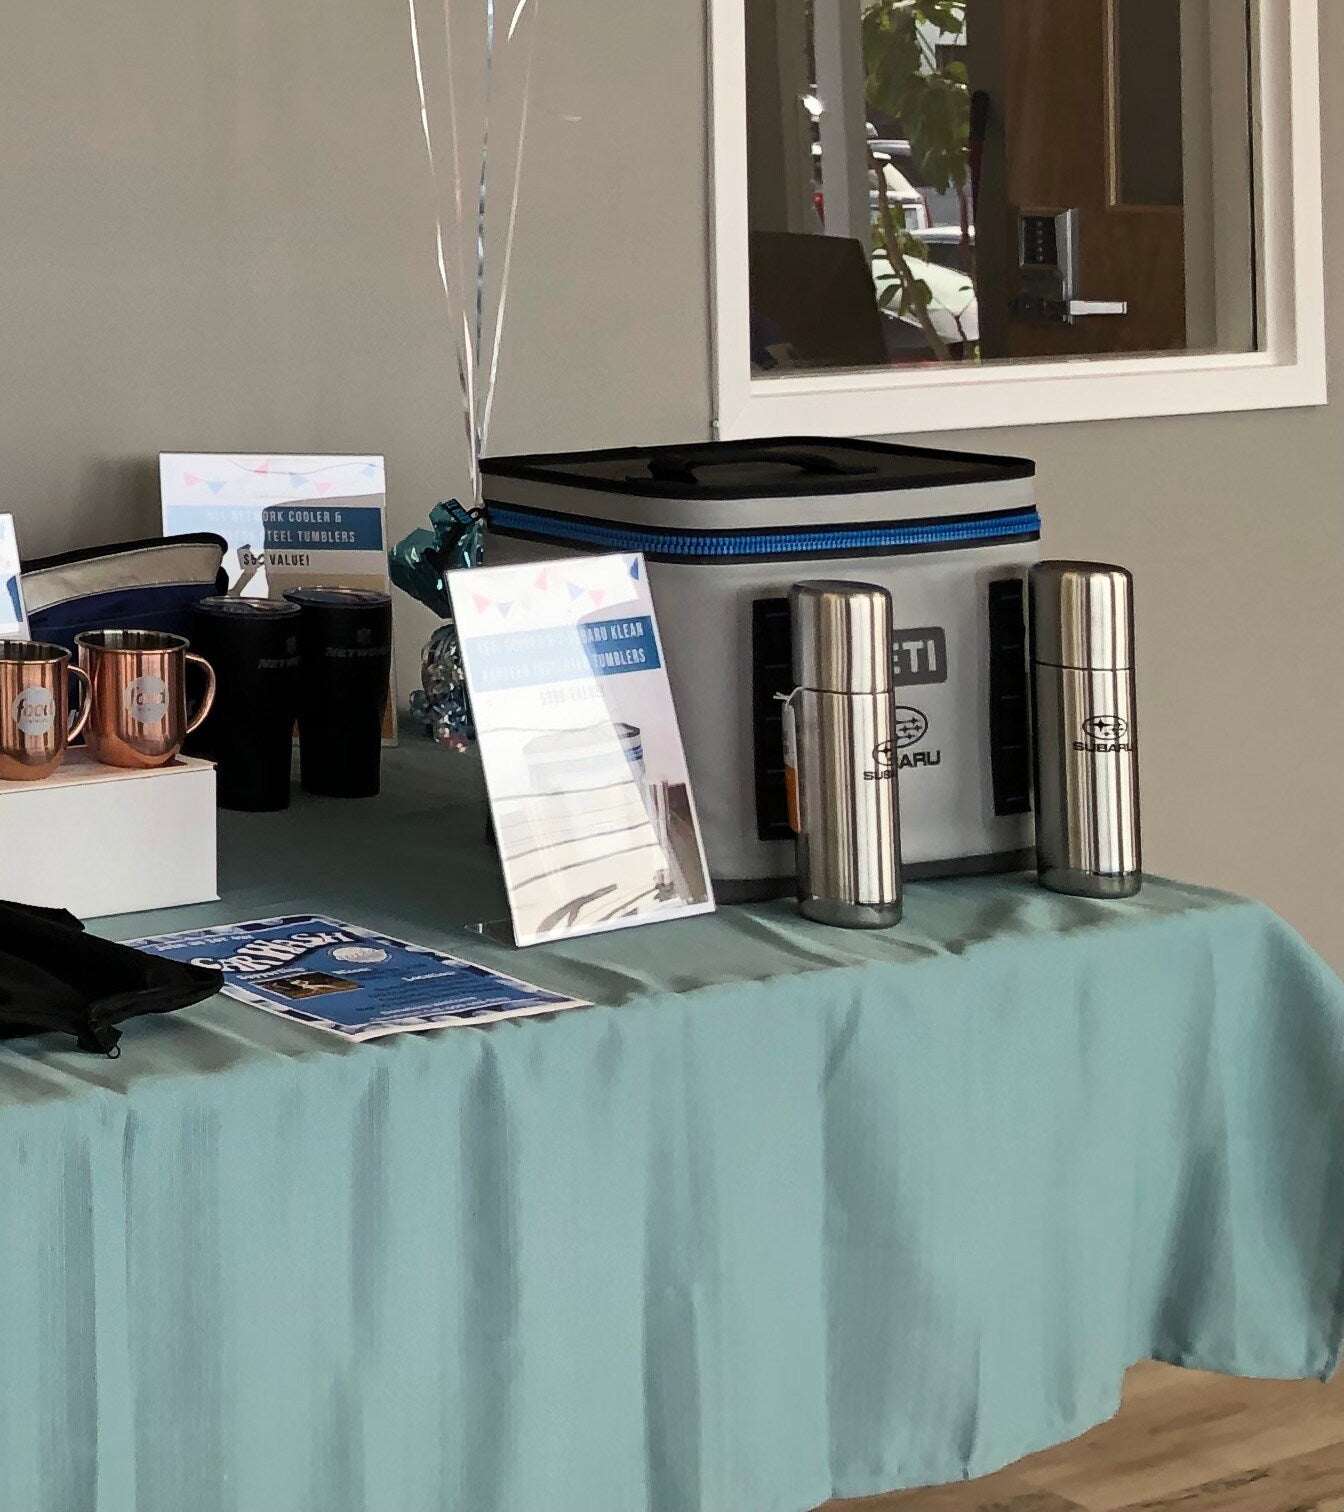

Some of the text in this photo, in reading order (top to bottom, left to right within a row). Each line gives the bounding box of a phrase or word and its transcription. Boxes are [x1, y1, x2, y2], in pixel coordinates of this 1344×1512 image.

[288, 510, 331, 523] COOLER
[334, 510, 343, 523] &
[297, 530, 356, 544] TUMBLERS
[269, 553, 310, 567] VALUE!
[609, 621, 645, 641] KLEAN
[592, 647, 647, 669] TUMBLERS
